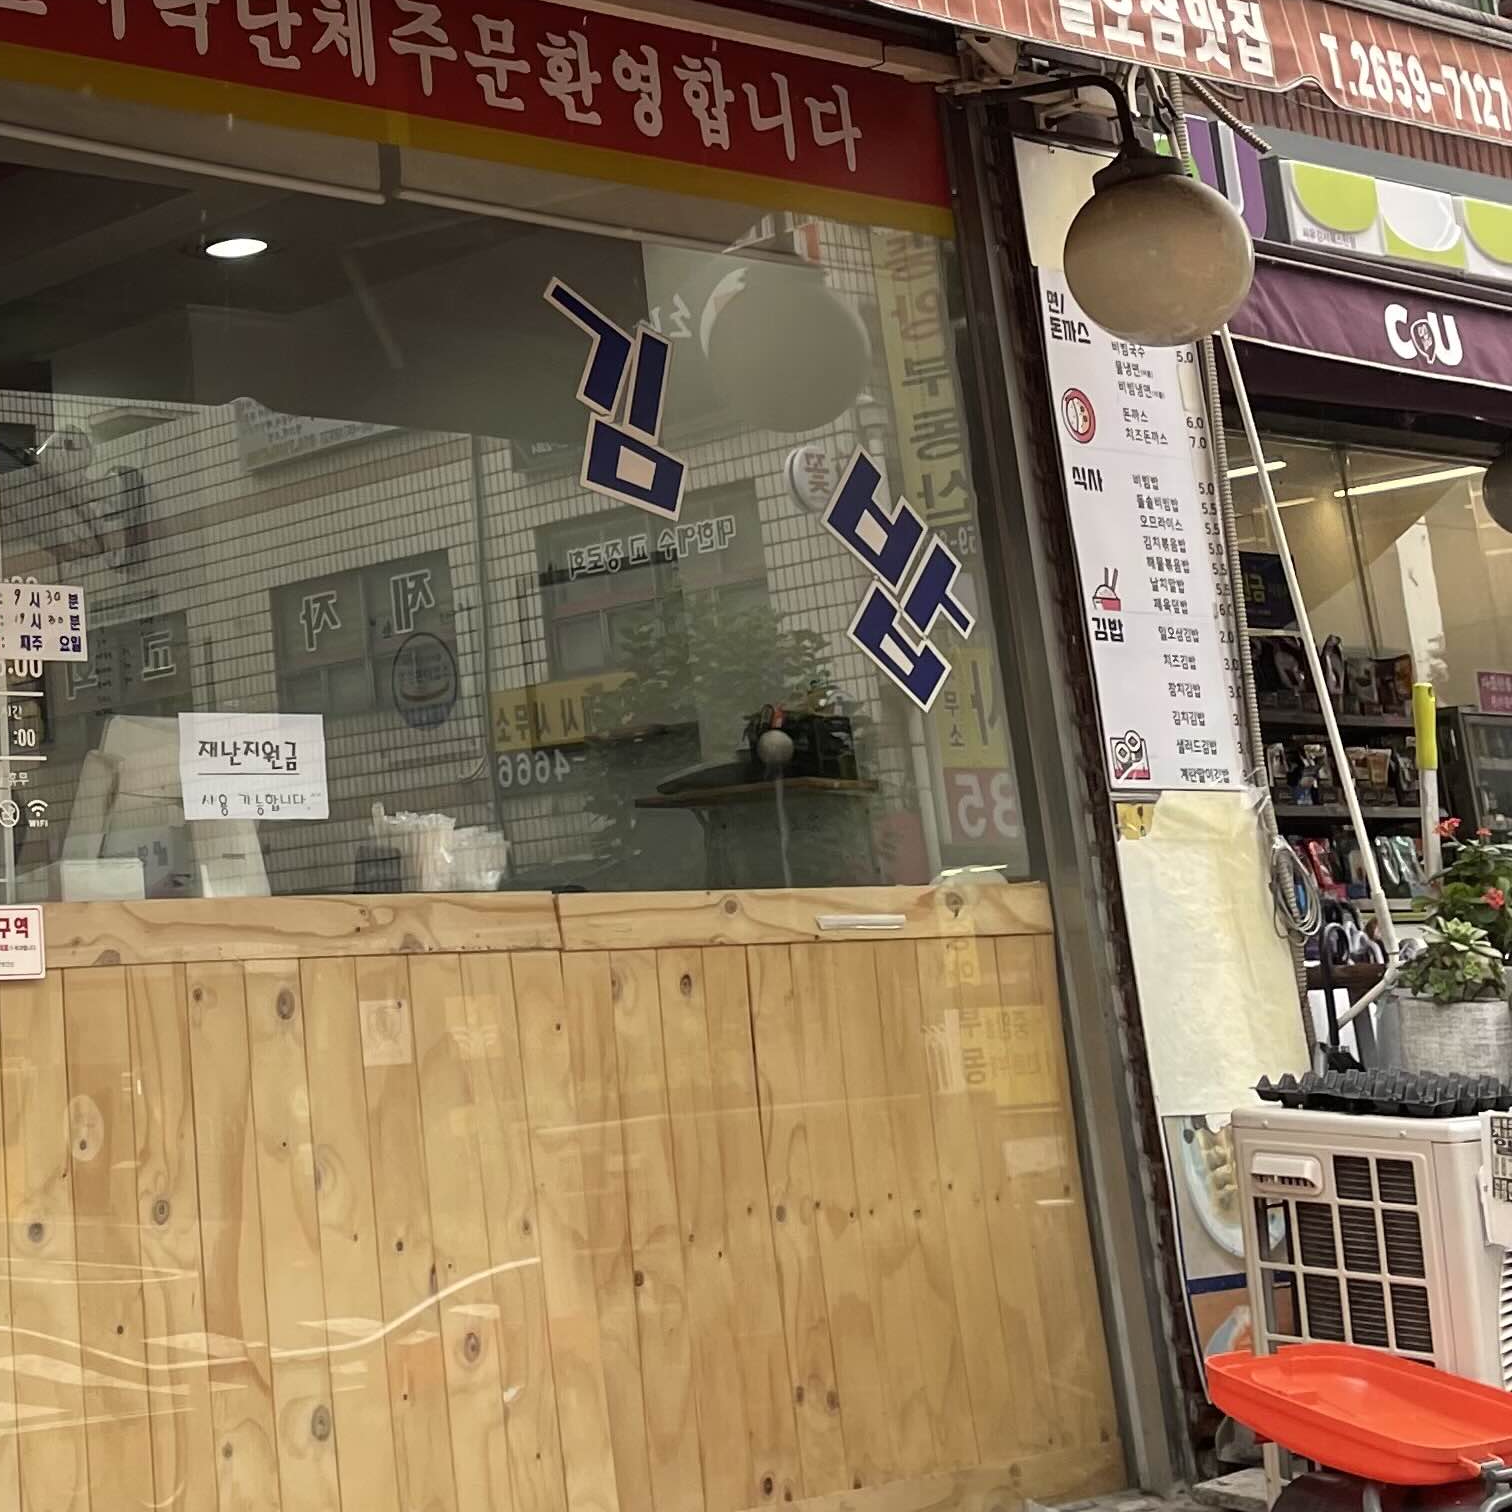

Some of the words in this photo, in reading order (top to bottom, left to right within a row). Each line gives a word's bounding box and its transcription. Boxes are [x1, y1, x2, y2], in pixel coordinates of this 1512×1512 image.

[1050, 316, 1091, 344] 돈까스
[1385, 304, 1464, 366] CU
[1176, 351, 1193, 363] 5.0
[1186, 416, 1204, 429] 6.0
[1190, 436, 1207, 448] 7.0
[1072, 466, 1103, 492] 식사
[1199, 482, 1214, 495] 5.0
[1092, 617, 1124, 643] 김밥
[198, 740, 297, 771] 재난지원금
